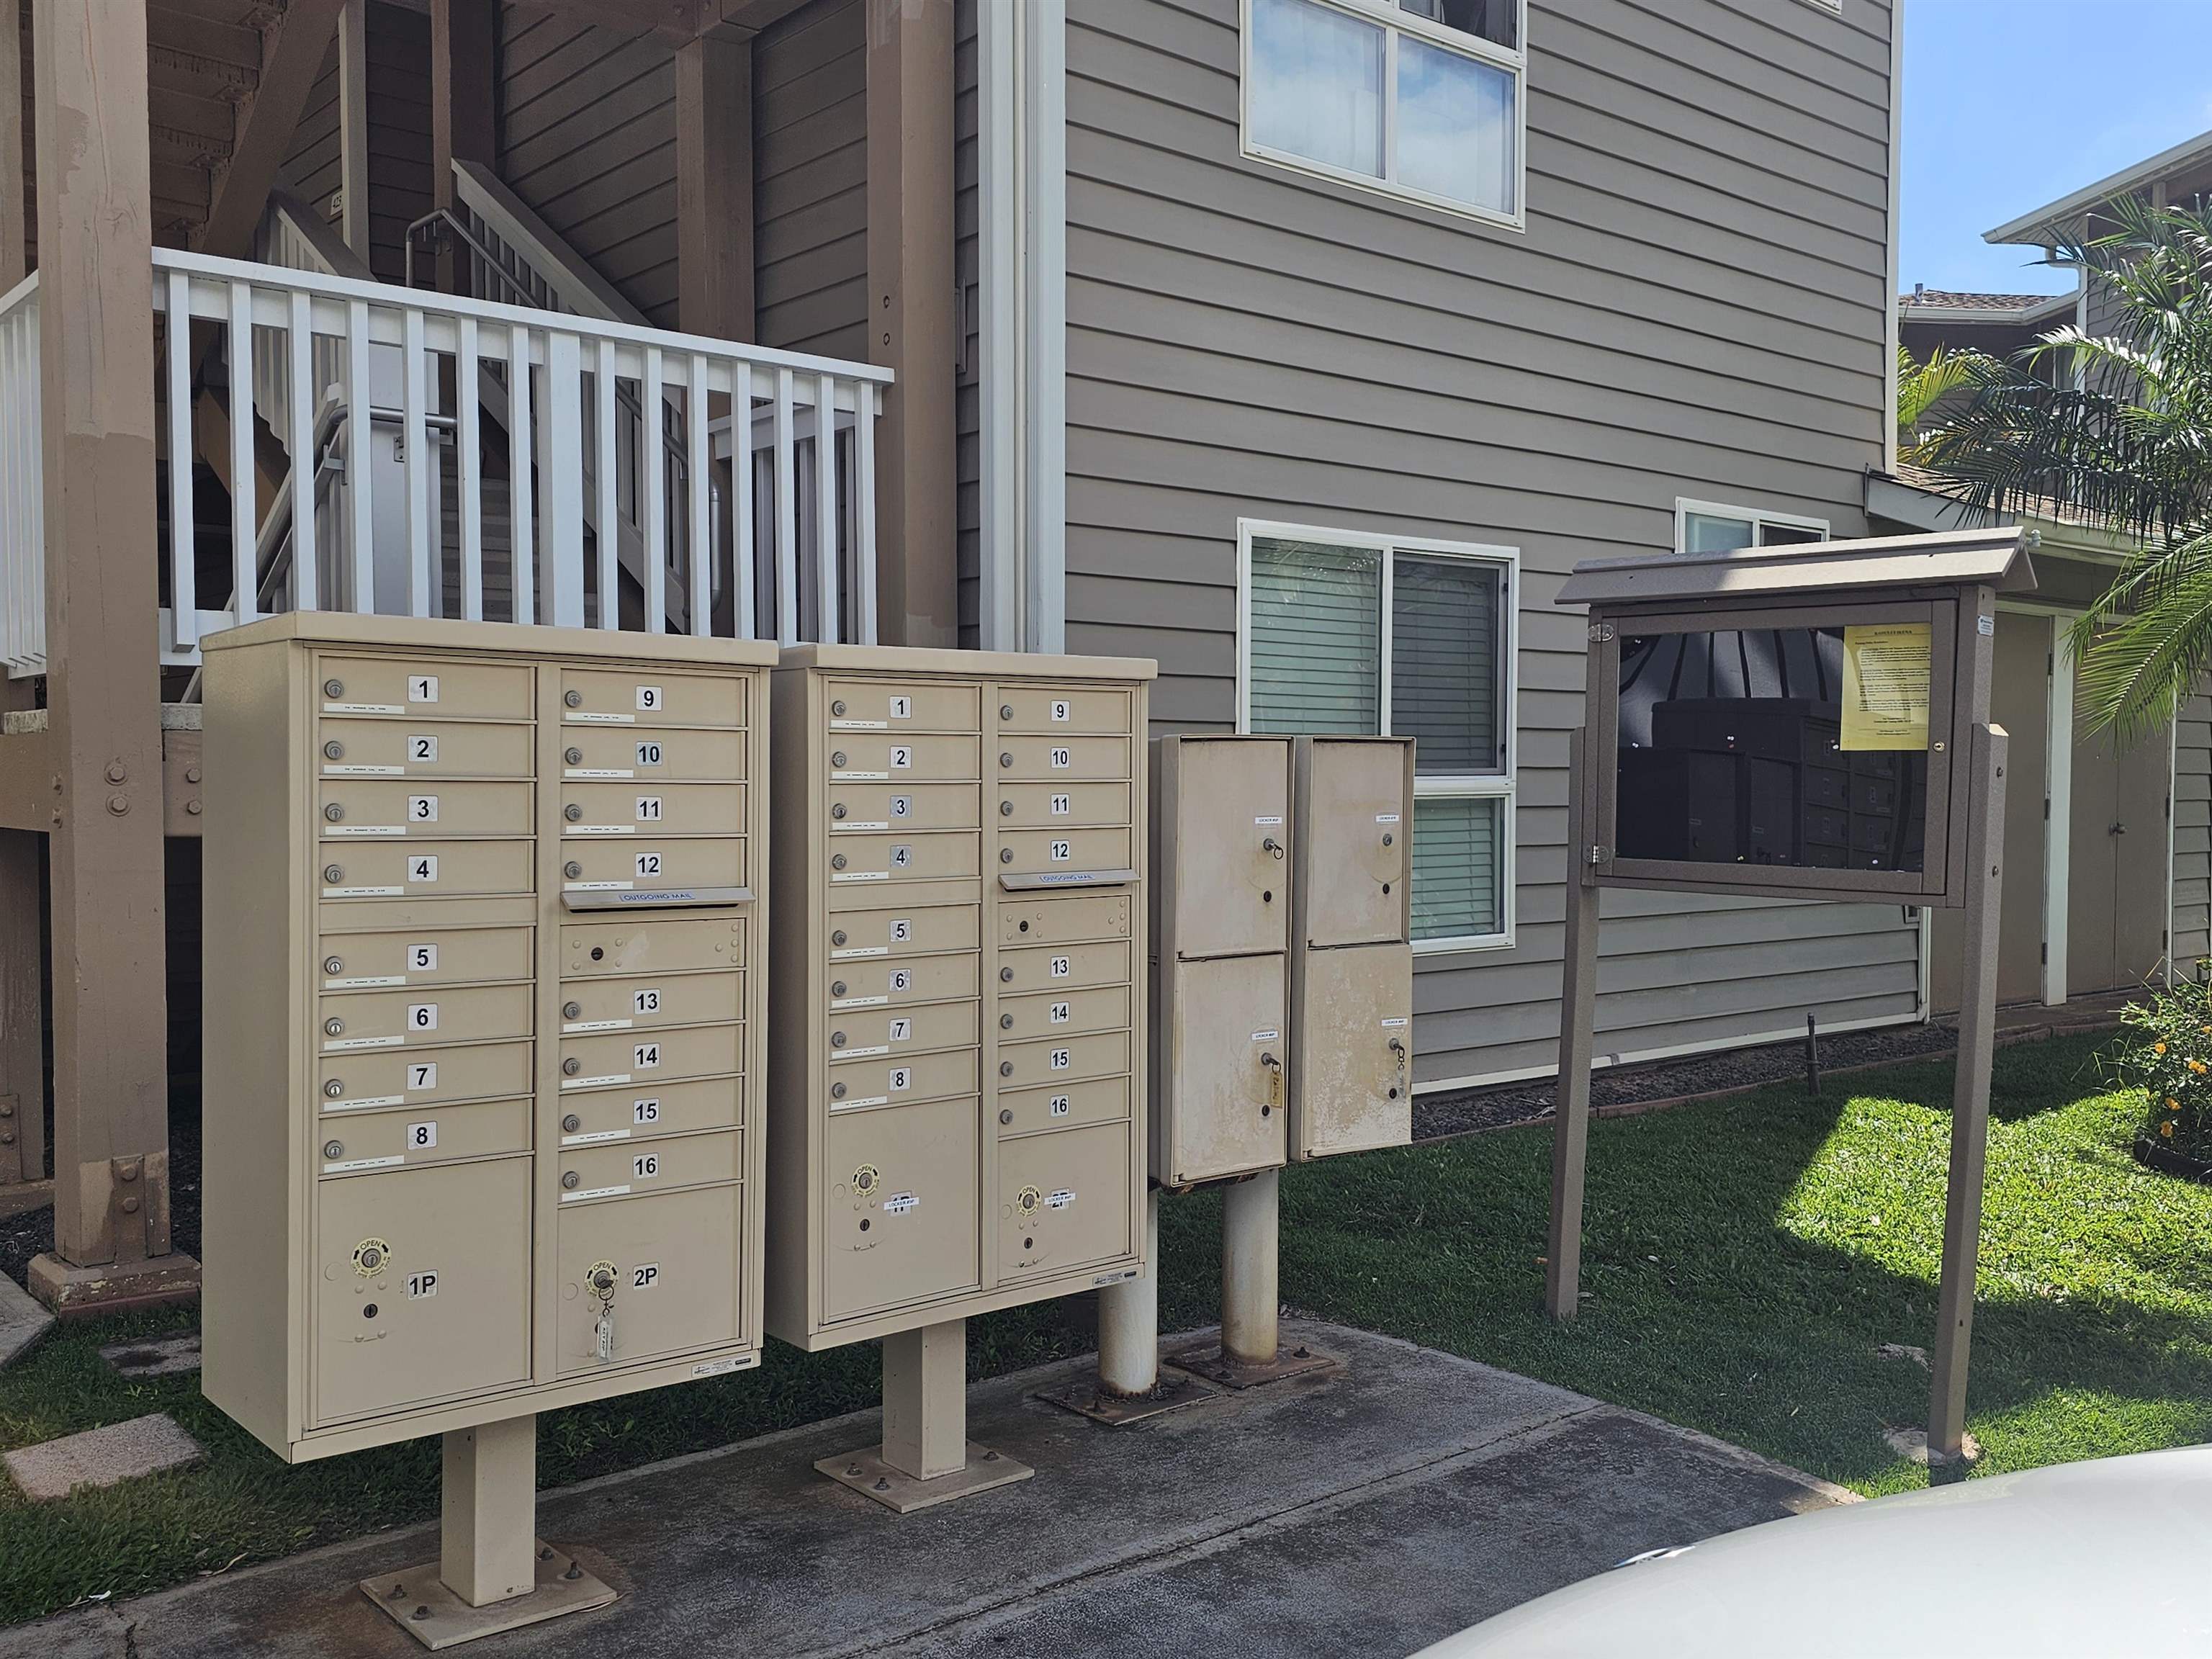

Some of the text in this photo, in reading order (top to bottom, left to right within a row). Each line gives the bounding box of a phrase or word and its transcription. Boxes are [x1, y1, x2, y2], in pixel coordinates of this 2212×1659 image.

[419, 680, 428, 698] 1
[644, 690, 655, 707] 9
[897, 699, 904, 715] 1
[1056, 703, 1064, 719] 9
[417, 739, 429, 758] 2
[639, 745, 660, 763] 10
[896, 750, 905, 765] 2
[1053, 750, 1068, 765] 10
[417, 799, 429, 818] 3
[639, 801, 658, 817] 11
[896, 799, 905, 814] 3
[1053, 797, 1067, 811] 11
[896, 849, 906, 864] 4
[1053, 843, 1068, 858] 12
[416, 860, 429, 878] 4
[638, 856, 659, 873] 12
[896, 923, 905, 938] 5
[417, 948, 428, 966] 5
[1053, 959, 1068, 974] 13
[896, 973, 904, 988] 6
[637, 993, 657, 1010] 13
[416, 1008, 428, 1026] 6
[1052, 1005, 1068, 1020] 14
[896, 1022, 904, 1038] 7
[636, 1047, 657, 1065] 14
[1052, 1051, 1068, 1066] 15
[416, 1067, 428, 1086] 7
[896, 1071, 904, 1087] 8
[636, 1102, 657, 1120] 15
[1052, 1098, 1067, 1114] 16
[416, 1126, 428, 1145] 8
[635, 1157, 656, 1176] 16
[858, 1166, 872, 1174] OPEN
[360, 1239, 381, 1250] OPEN
[409, 1274, 436, 1295] 1P
[634, 1267, 657, 1287] 2P
